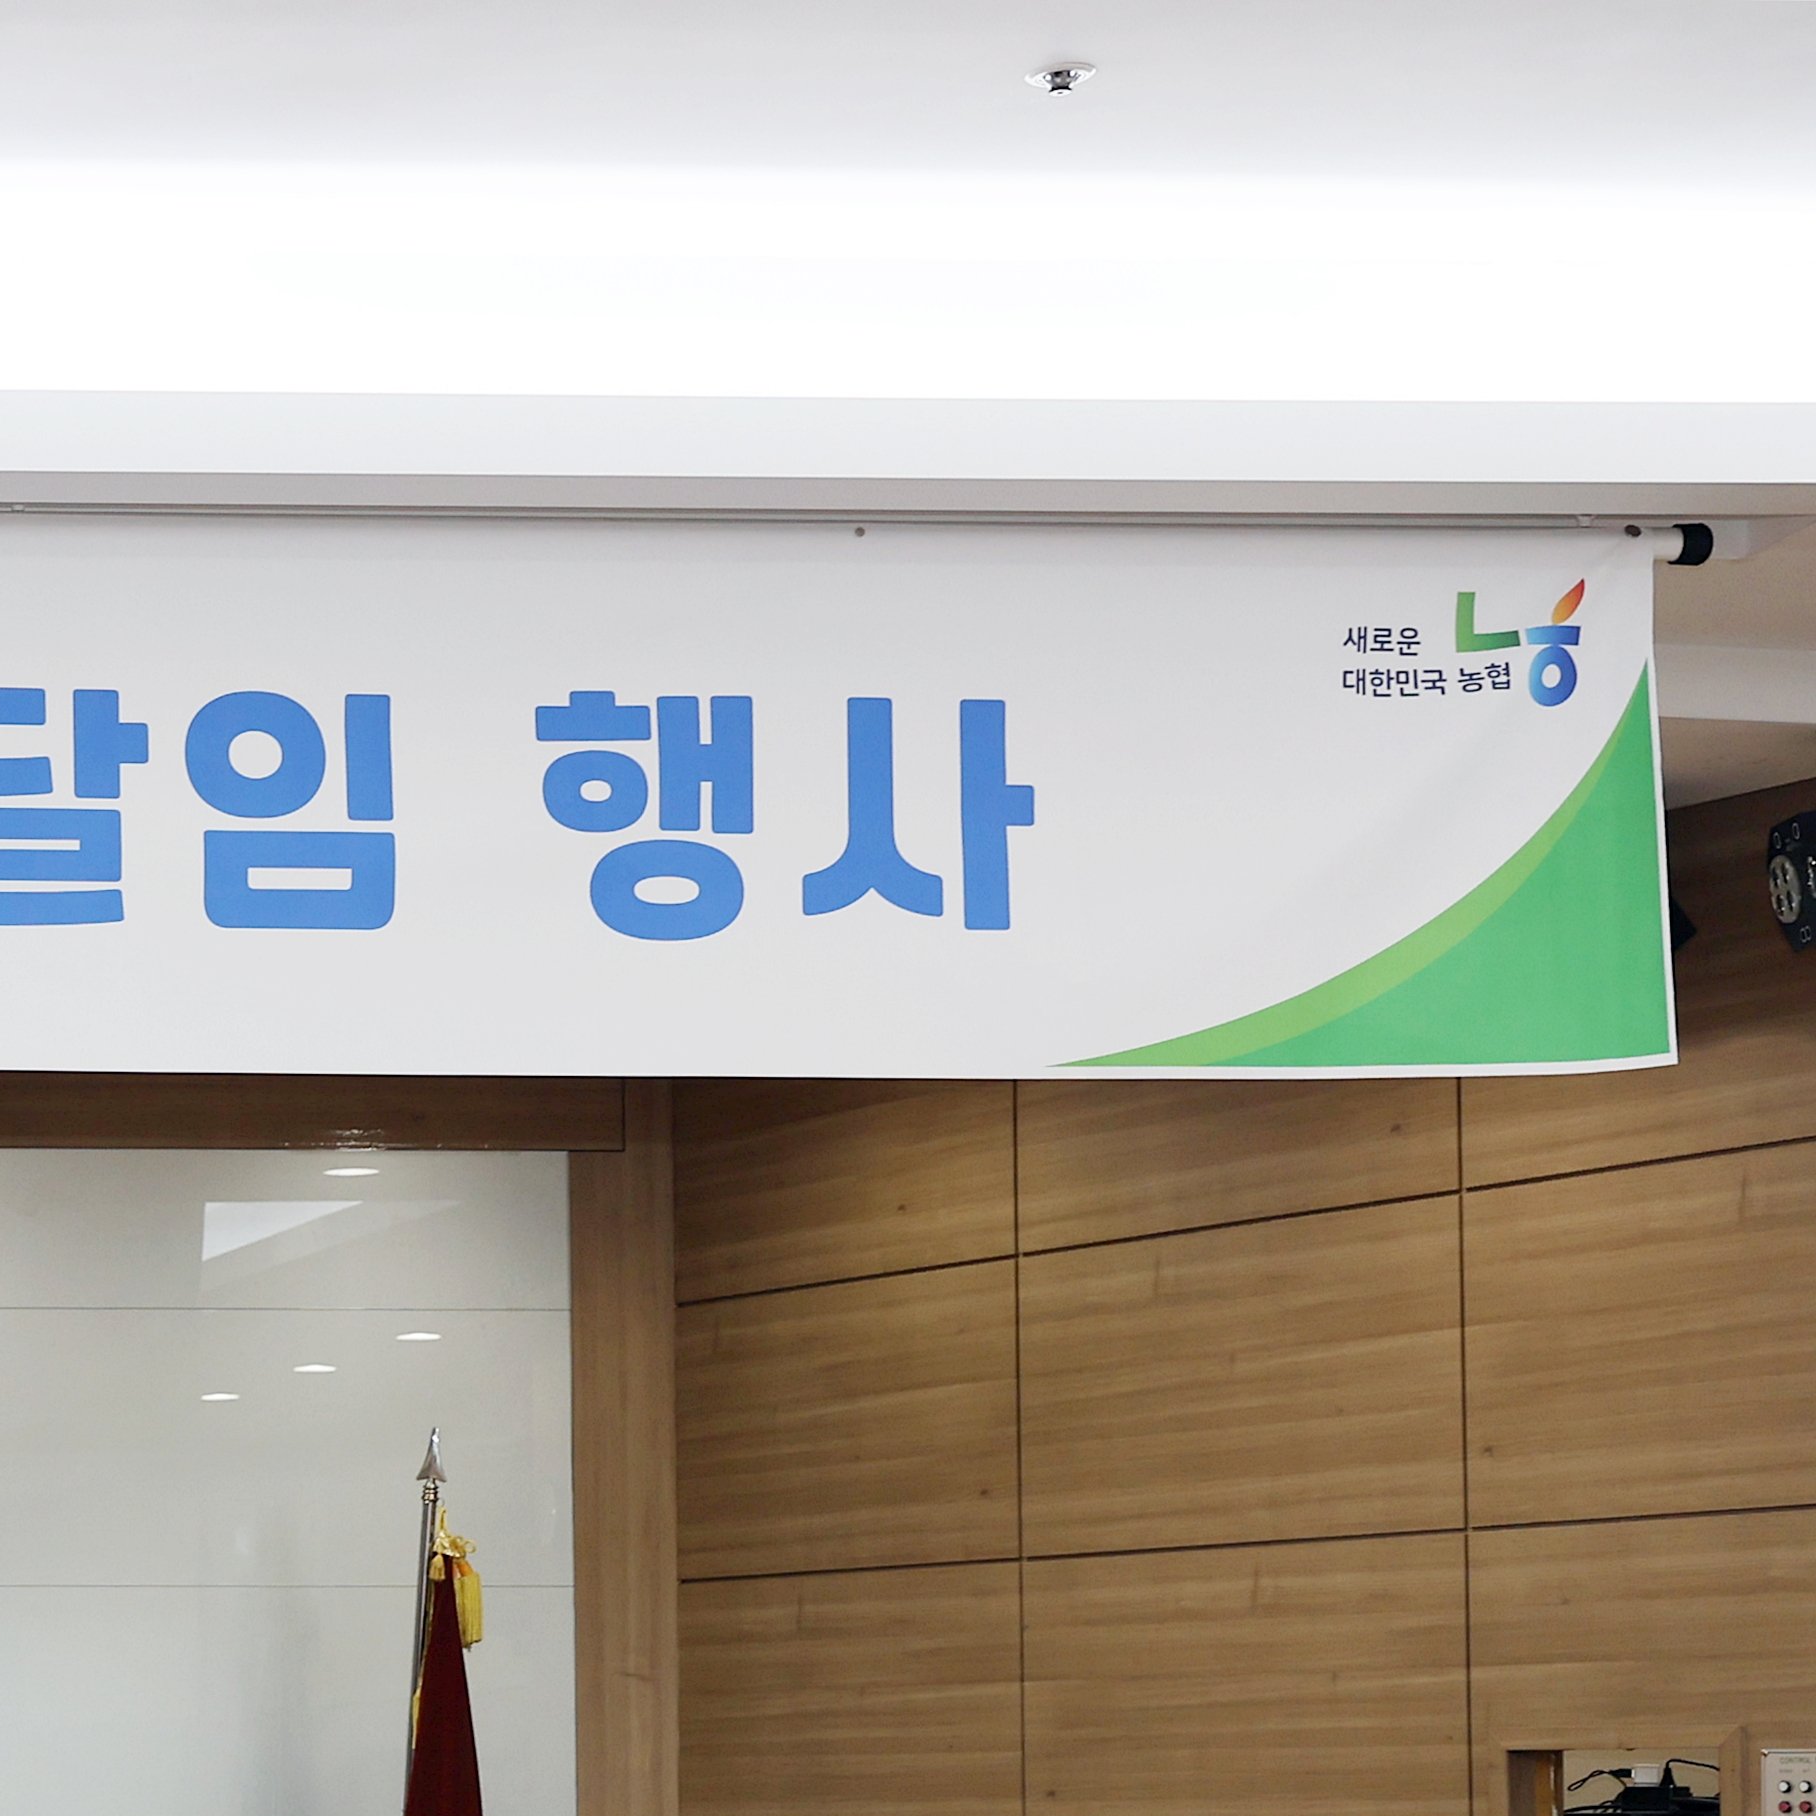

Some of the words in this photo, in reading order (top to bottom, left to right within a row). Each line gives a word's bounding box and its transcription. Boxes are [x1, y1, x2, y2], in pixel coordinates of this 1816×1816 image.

[1343, 626, 1421, 656] 새로운
[1342, 668, 1447, 697] 대한민국
[1457, 662, 1511, 693] 농협
[535, 690, 1035, 939] 행사
